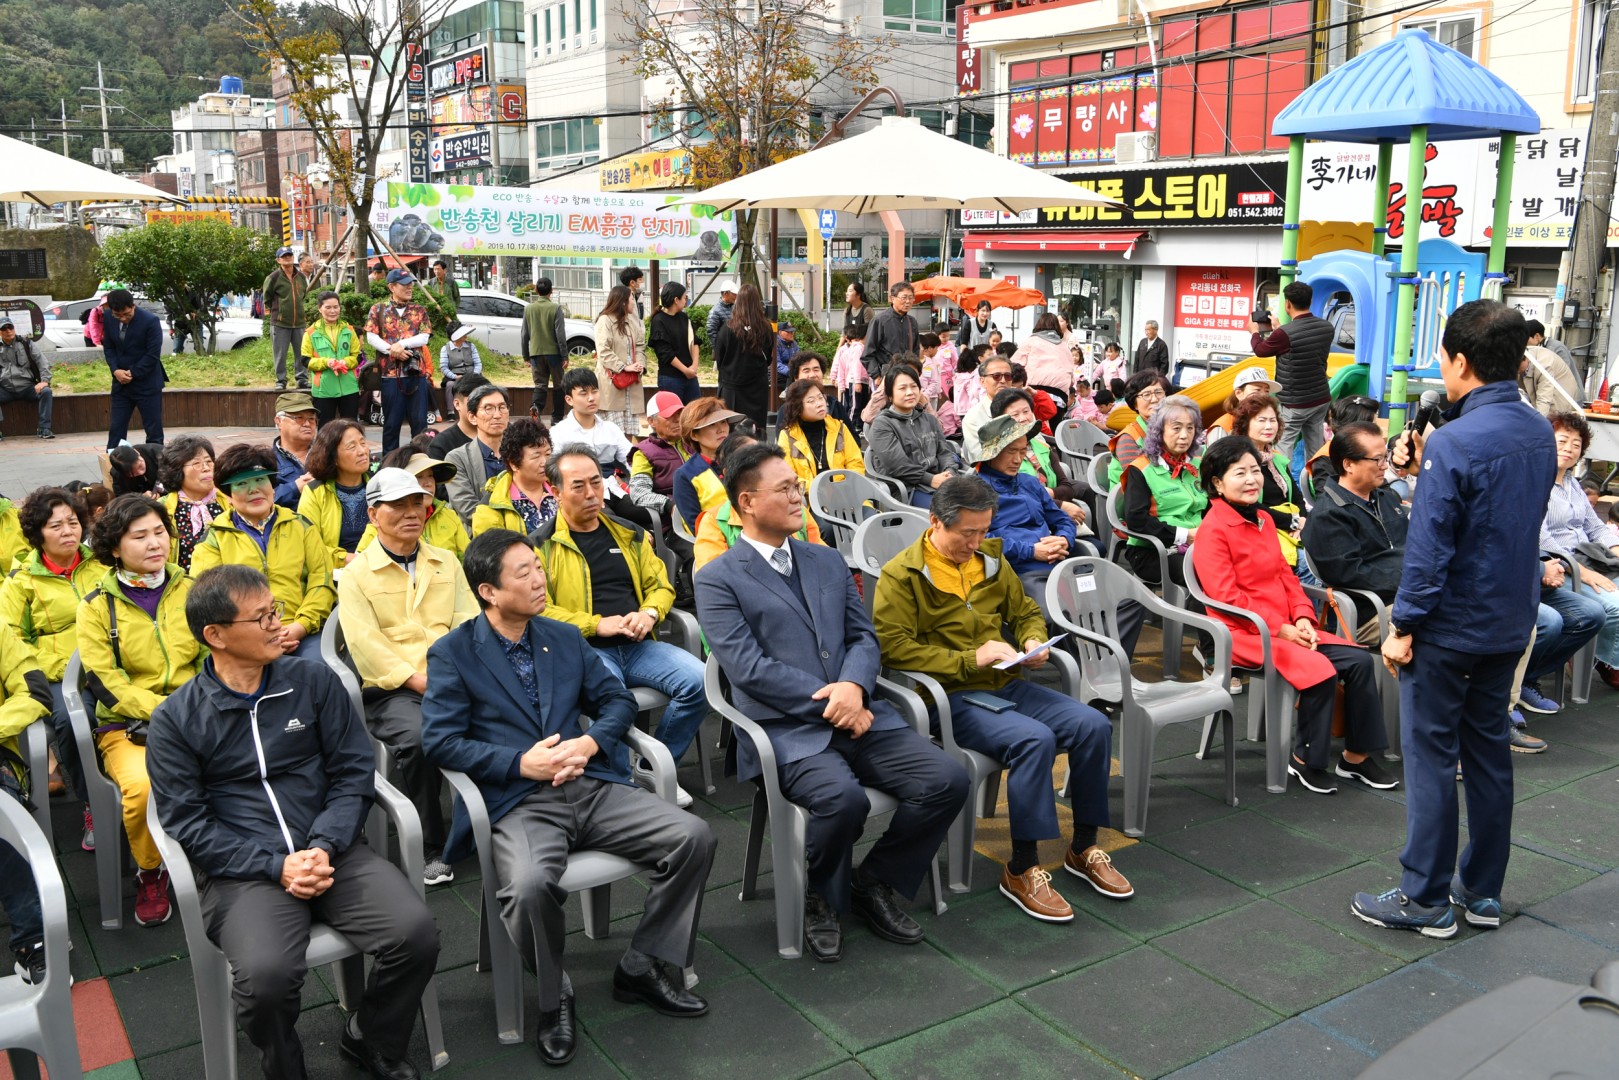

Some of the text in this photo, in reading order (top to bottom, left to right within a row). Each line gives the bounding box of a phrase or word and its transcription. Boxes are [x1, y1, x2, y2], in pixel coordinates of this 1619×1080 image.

[1043, 100, 1128, 133] 무량사
[445, 134, 490, 159] 반송한의원
[492, 193, 512, 201] eco
[515, 193, 532, 204] 반송
[543, 194, 568, 205] 수달과
[572, 195, 591, 206] 함께
[593, 197, 625, 207] 반송으로
[629, 198, 645, 207] 오다
[1133, 174, 1227, 220] 스토어
[1227, 207, 1284, 218] 051.542.3802
[440, 207, 691, 237] 반송천 살리기 EM흙공 던지기
[1529, 227, 1550, 238] 이상
[599, 245, 644, 253] 주민자치위원회
[1190, 282, 1241, 293] 우리동네 전화국
[1184, 317, 1201, 325] GIGA
